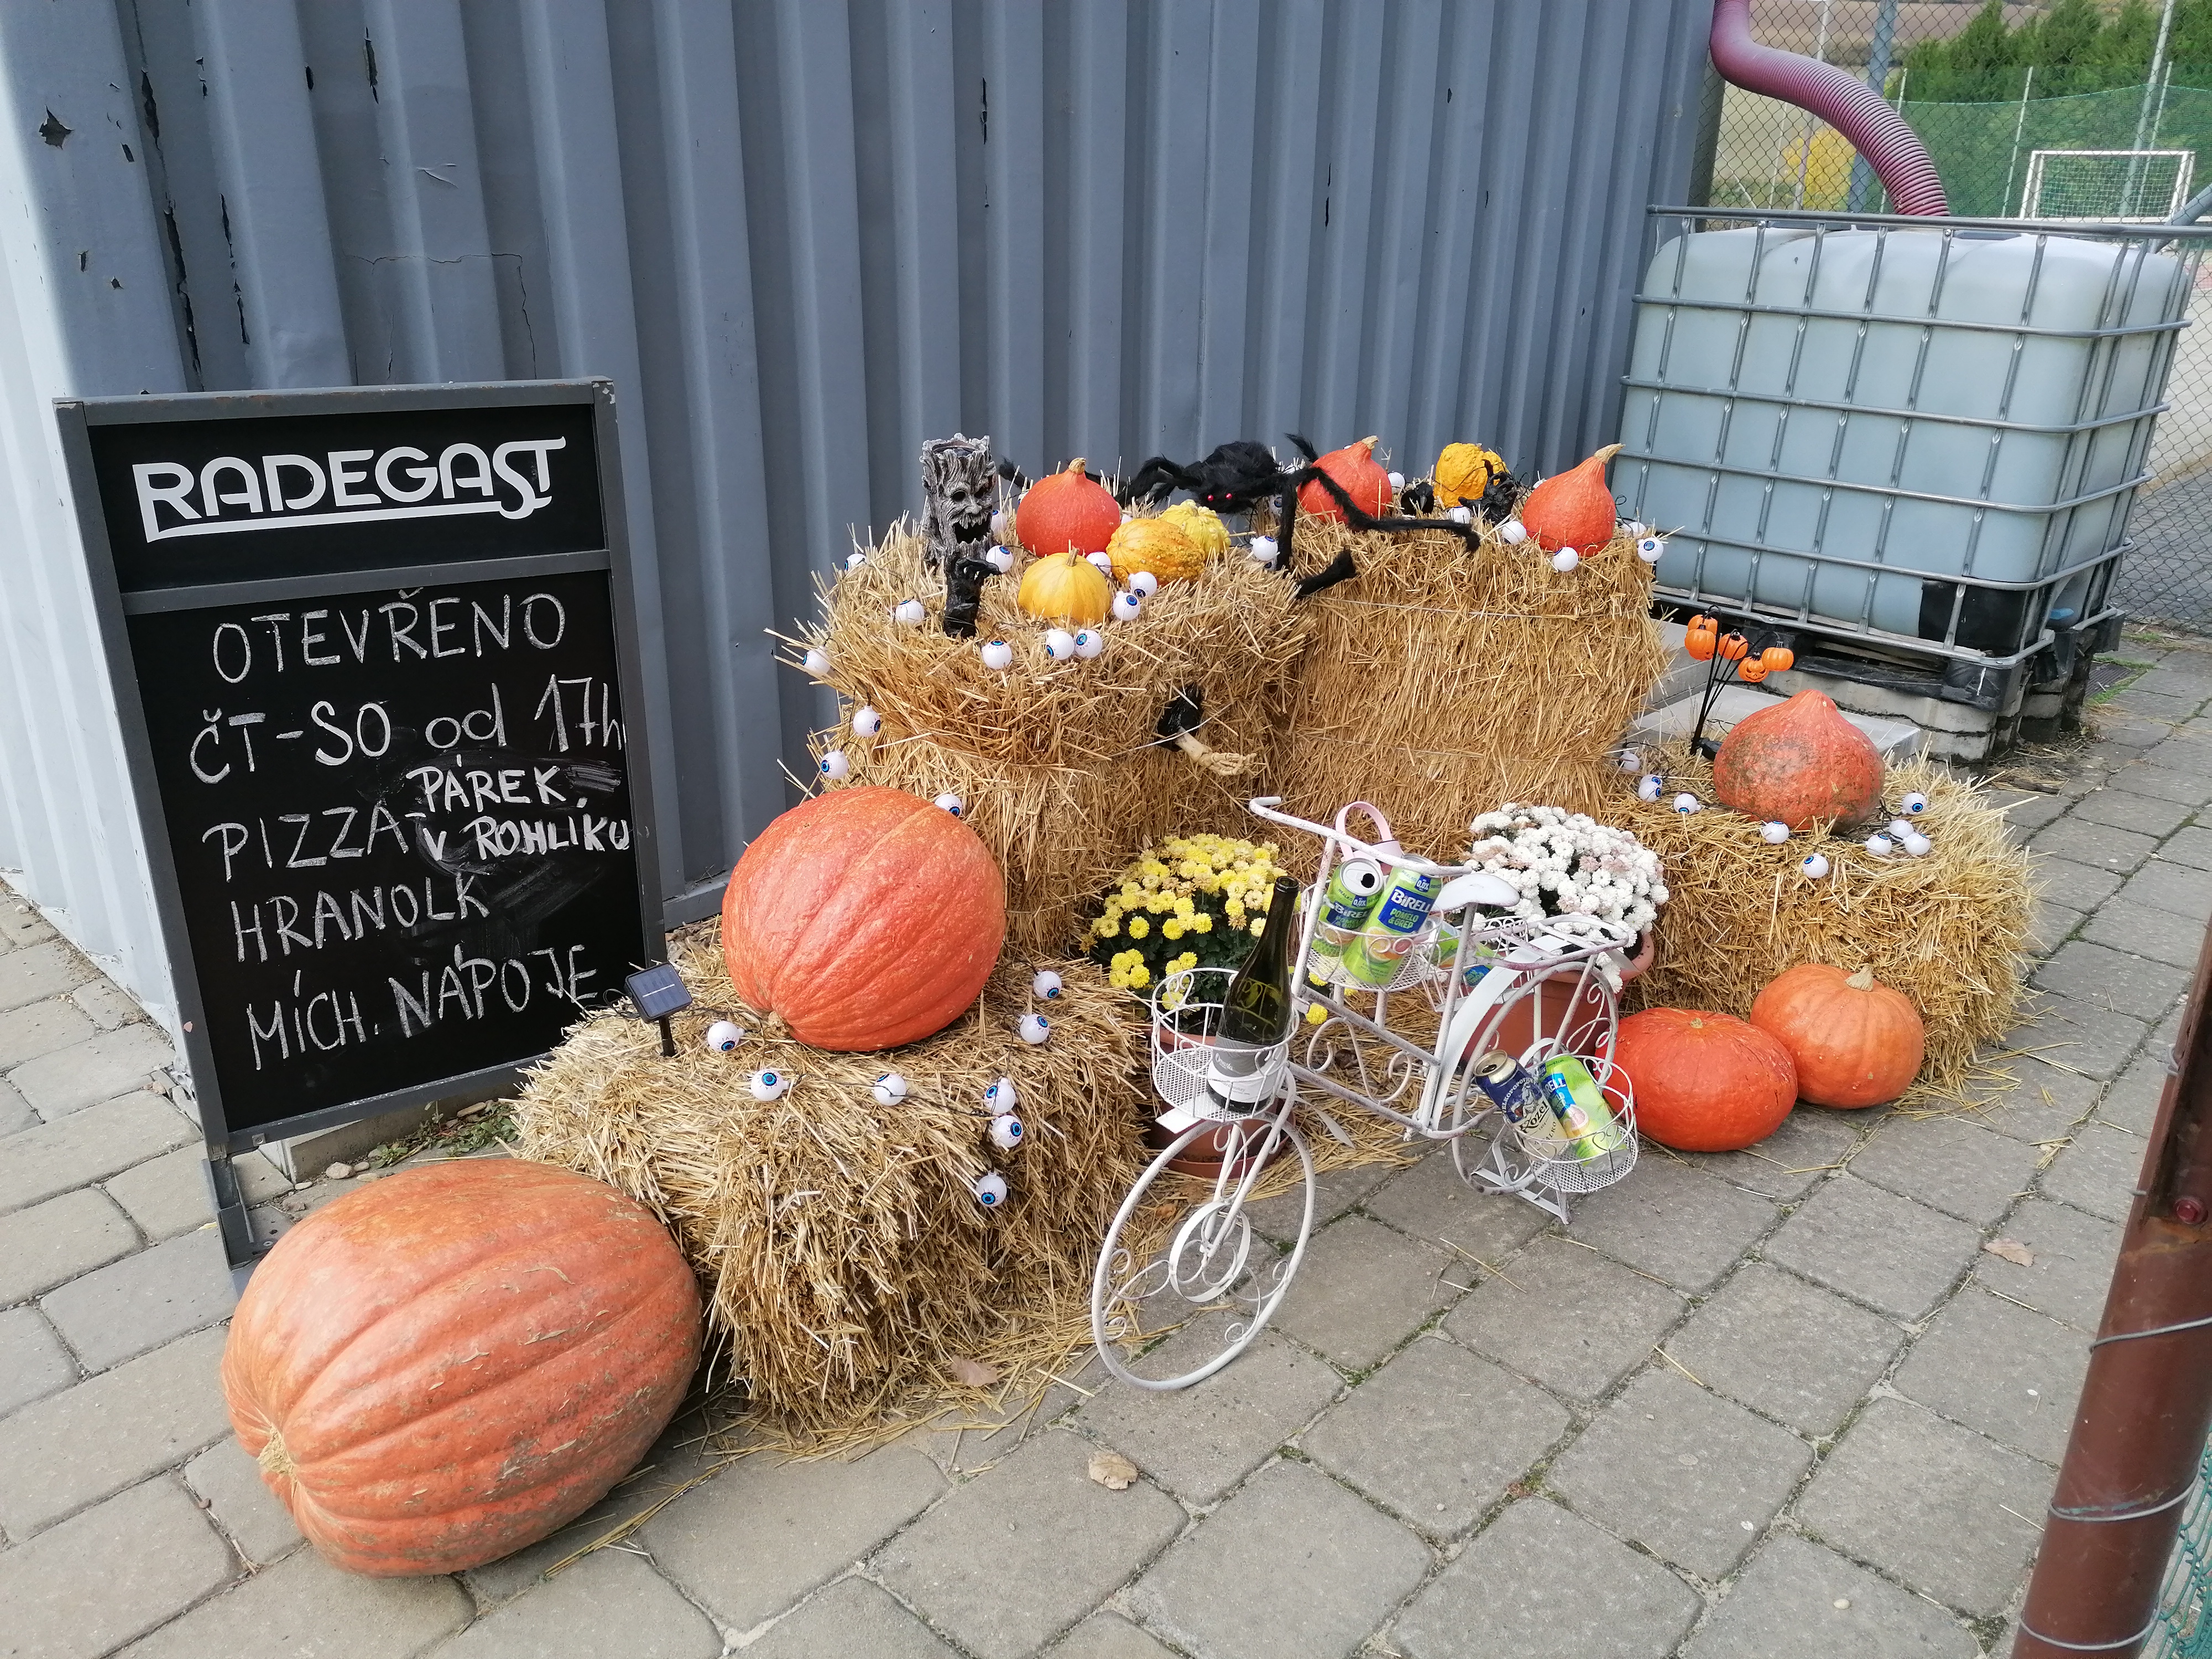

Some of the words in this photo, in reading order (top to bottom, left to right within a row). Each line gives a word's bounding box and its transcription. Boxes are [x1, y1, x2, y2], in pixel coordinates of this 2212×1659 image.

[132, 436, 566, 542] RADEGAST
[212, 587, 566, 683] OTEVŘENO
[425, 682, 507, 749] od
[534, 674, 626, 753] 17h
[406, 754, 567, 813] PÁREK
[459, 797, 630, 860] ROHLÍKU
[230, 872, 491, 963] HRANOLK
[1390, 908, 1419, 922] POMELO
[246, 969, 379, 1071] MÍCH.
[388, 943, 599, 1038] NÁPOJE
[1518, 1100, 1549, 1134] Kozel
